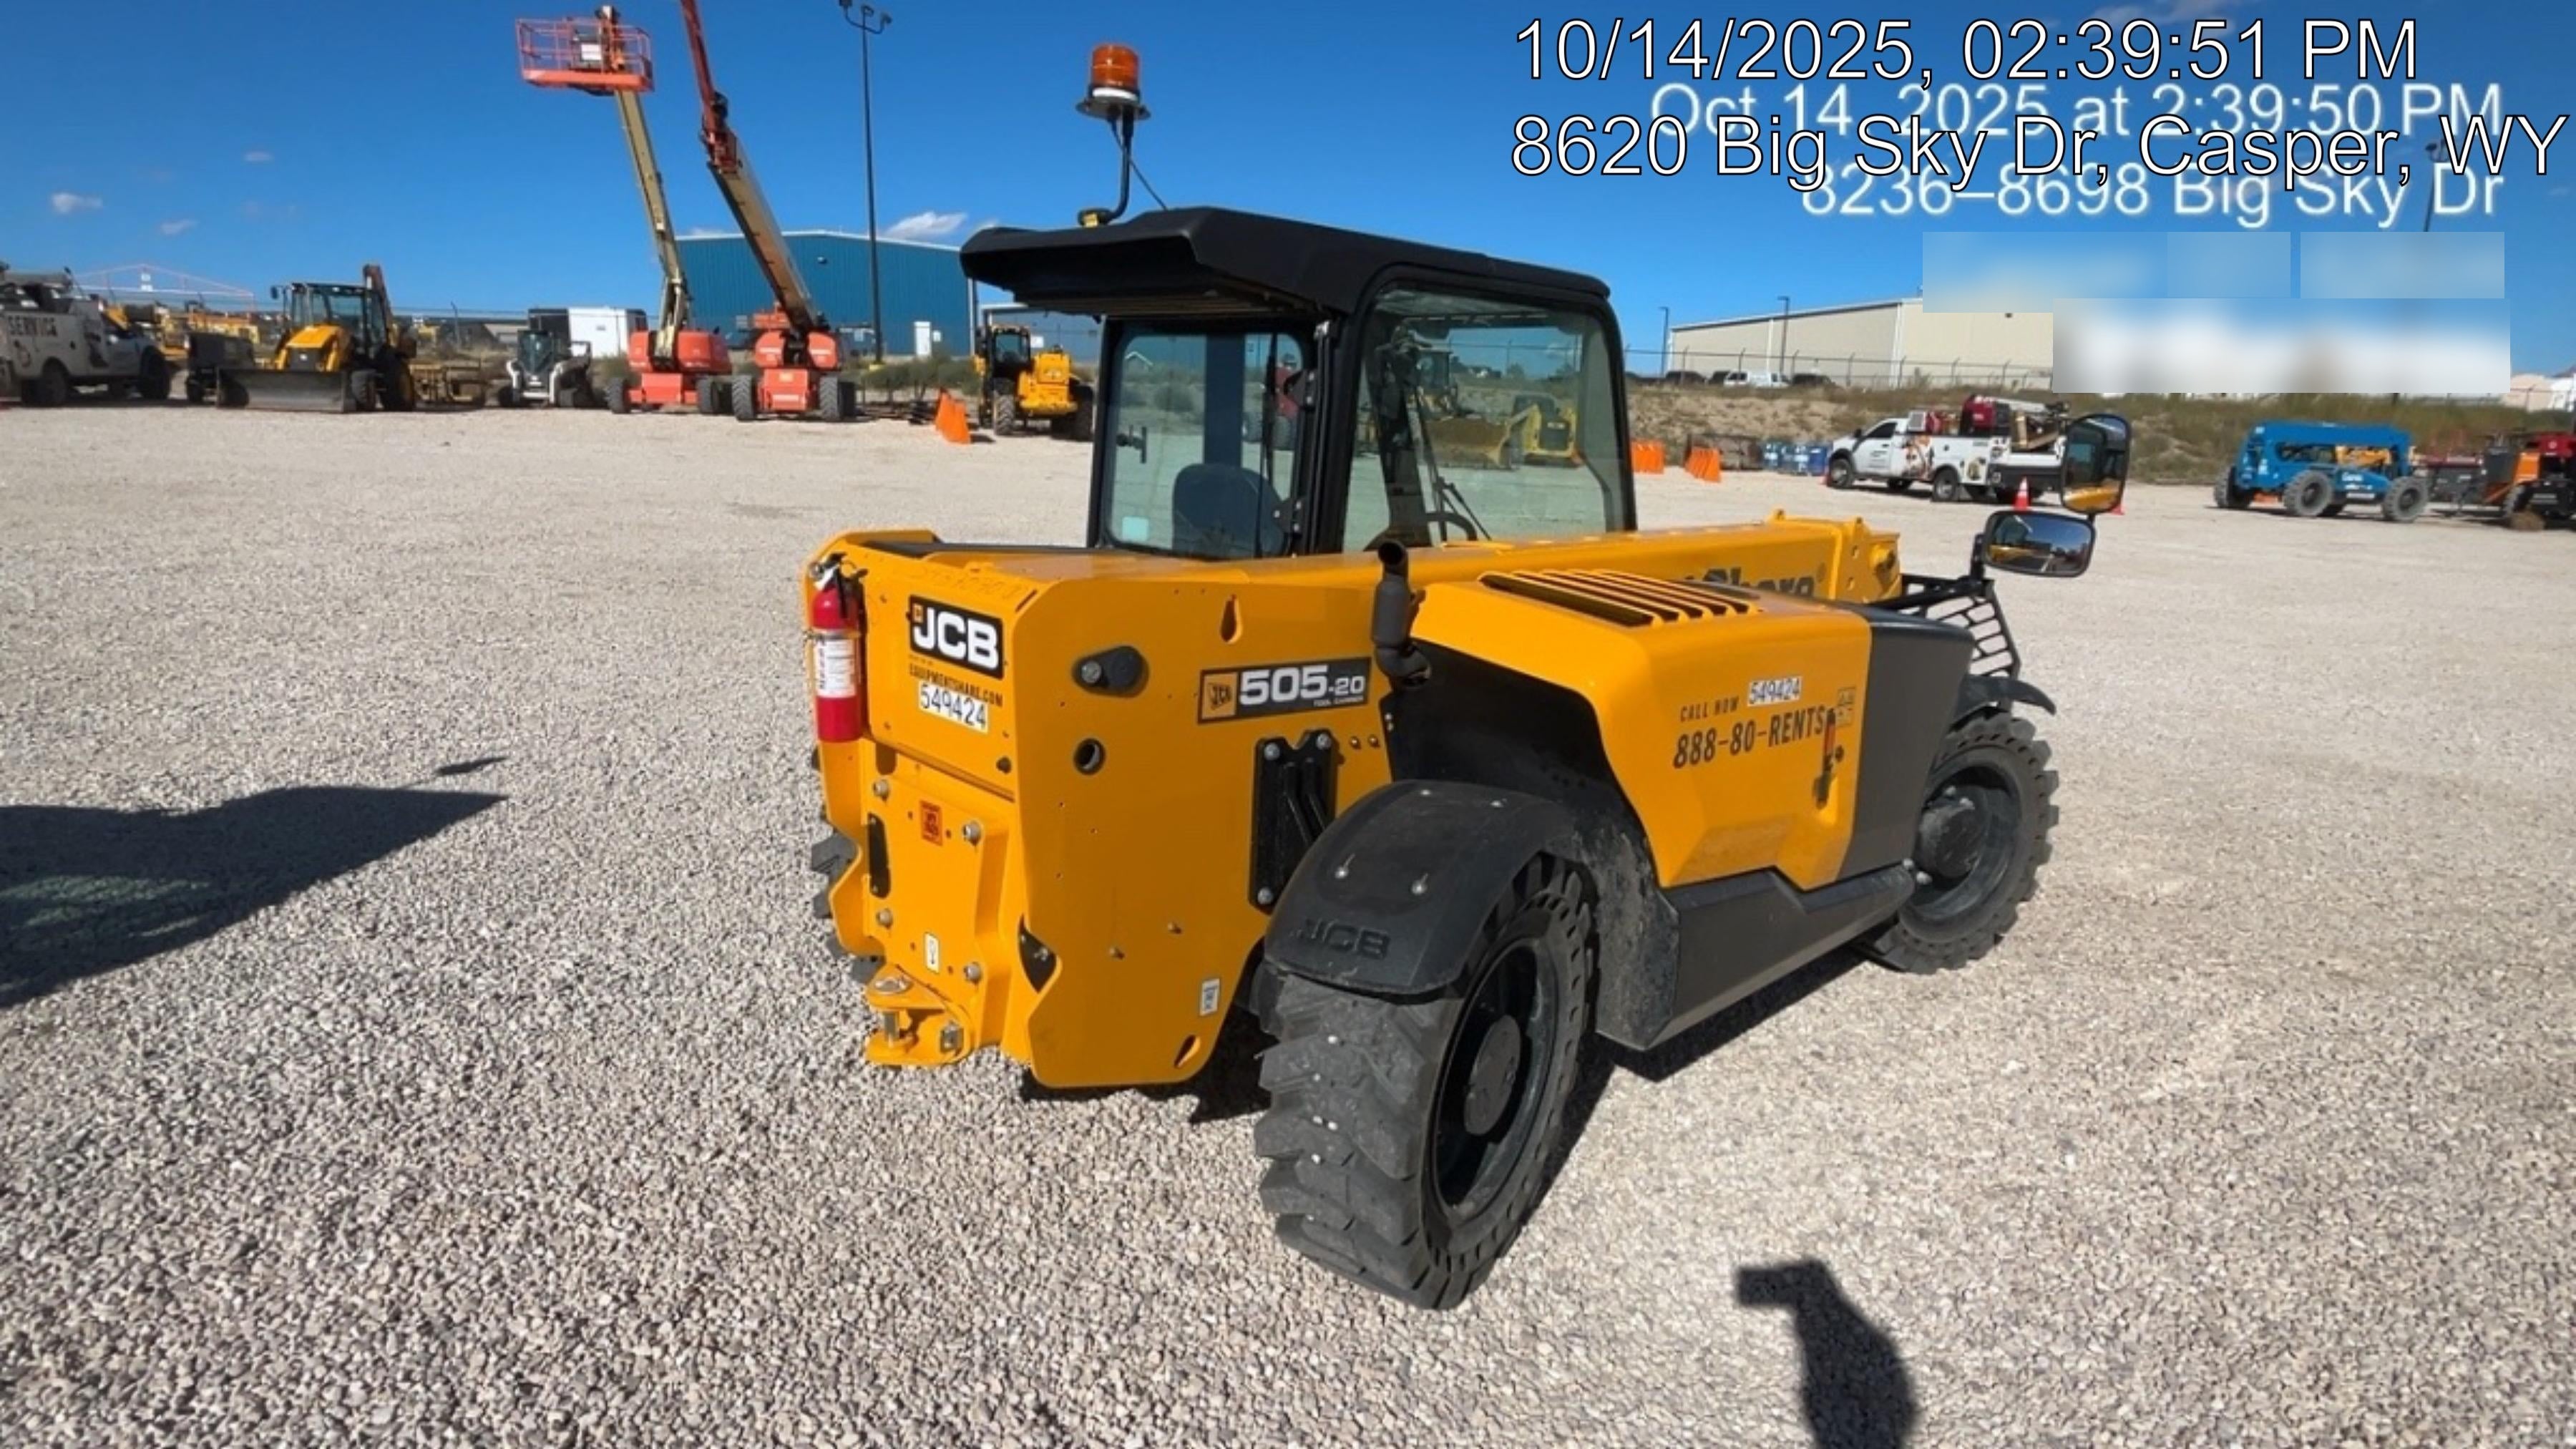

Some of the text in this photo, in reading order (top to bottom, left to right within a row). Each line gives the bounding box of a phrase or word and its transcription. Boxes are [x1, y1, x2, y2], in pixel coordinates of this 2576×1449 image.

[913, 606, 1000, 670] JCB
[920, 682, 987, 730] 549424
[1239, 663, 1366, 706] 505-20
[1749, 678, 1801, 705] 549424
[1680, 696, 1740, 723] CALL NOW
[1673, 705, 1826, 769] 888-80-RENTS
